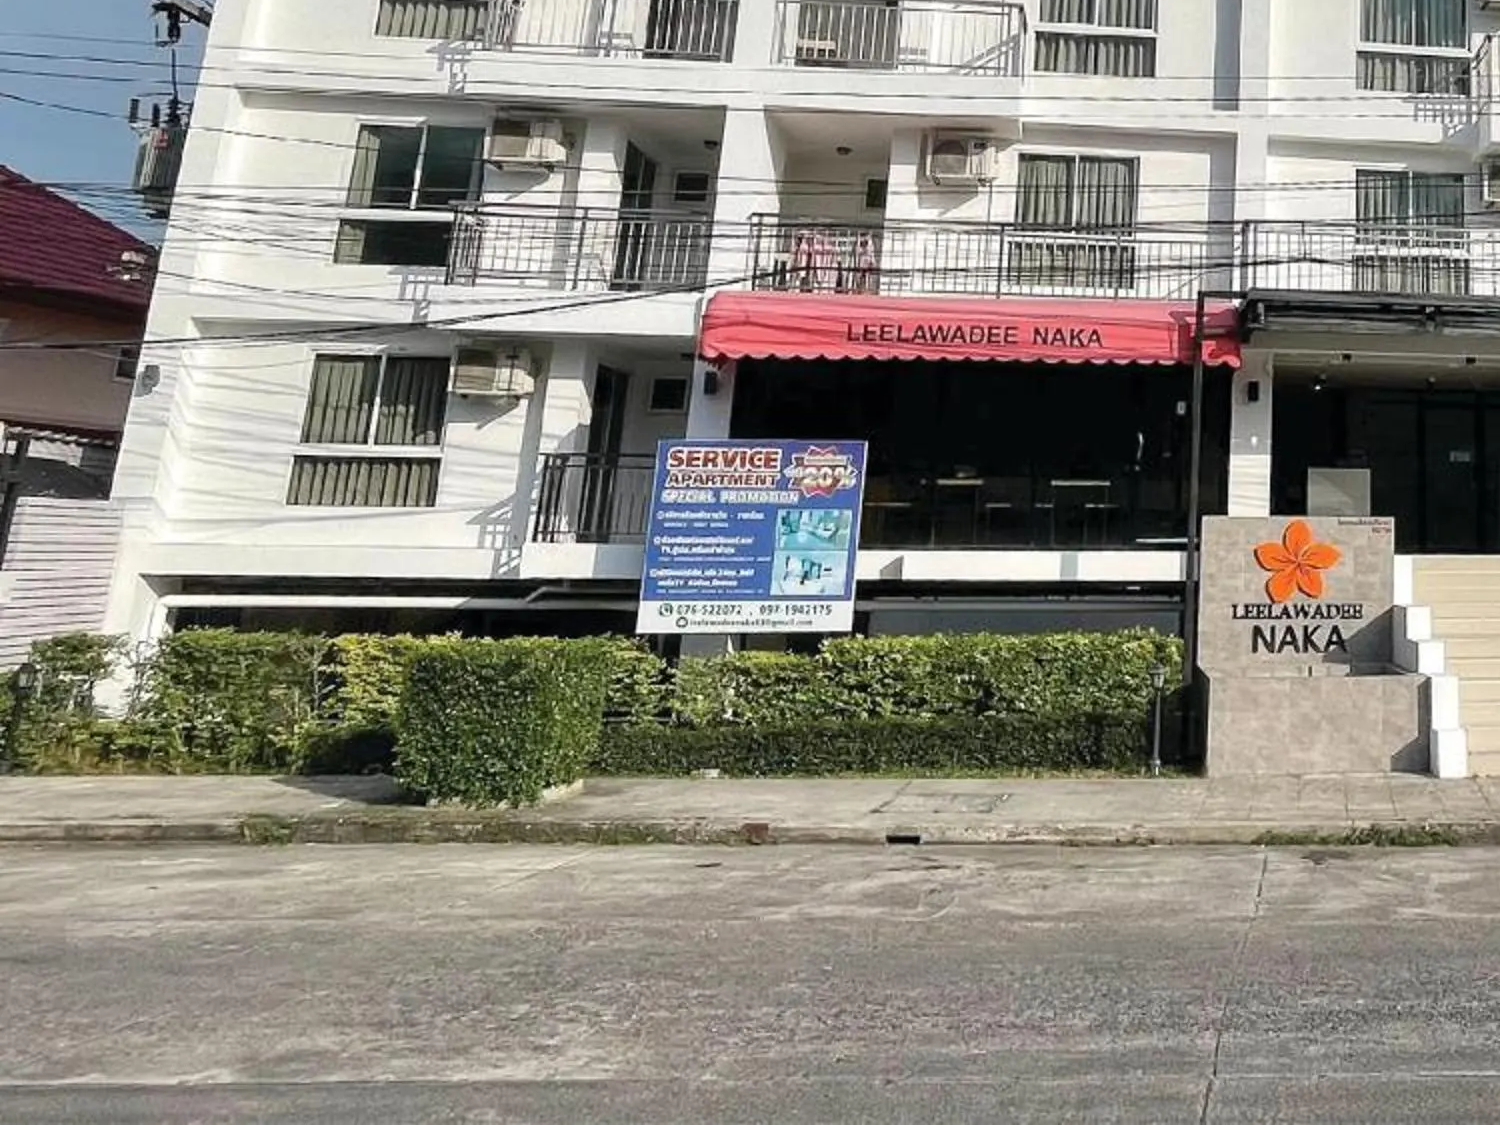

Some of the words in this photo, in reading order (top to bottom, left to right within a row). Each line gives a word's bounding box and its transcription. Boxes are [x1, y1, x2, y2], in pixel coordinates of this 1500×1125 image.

[847, 323, 1019, 345] LEELAWADEE
[1032, 326, 1103, 348] NAKA
[668, 448, 780, 471] SERVICE
[667, 473, 779, 487] APARTMENT
[1231, 603, 1364, 621] LEELAWADEE
[1251, 624, 1348, 654] NAKA
